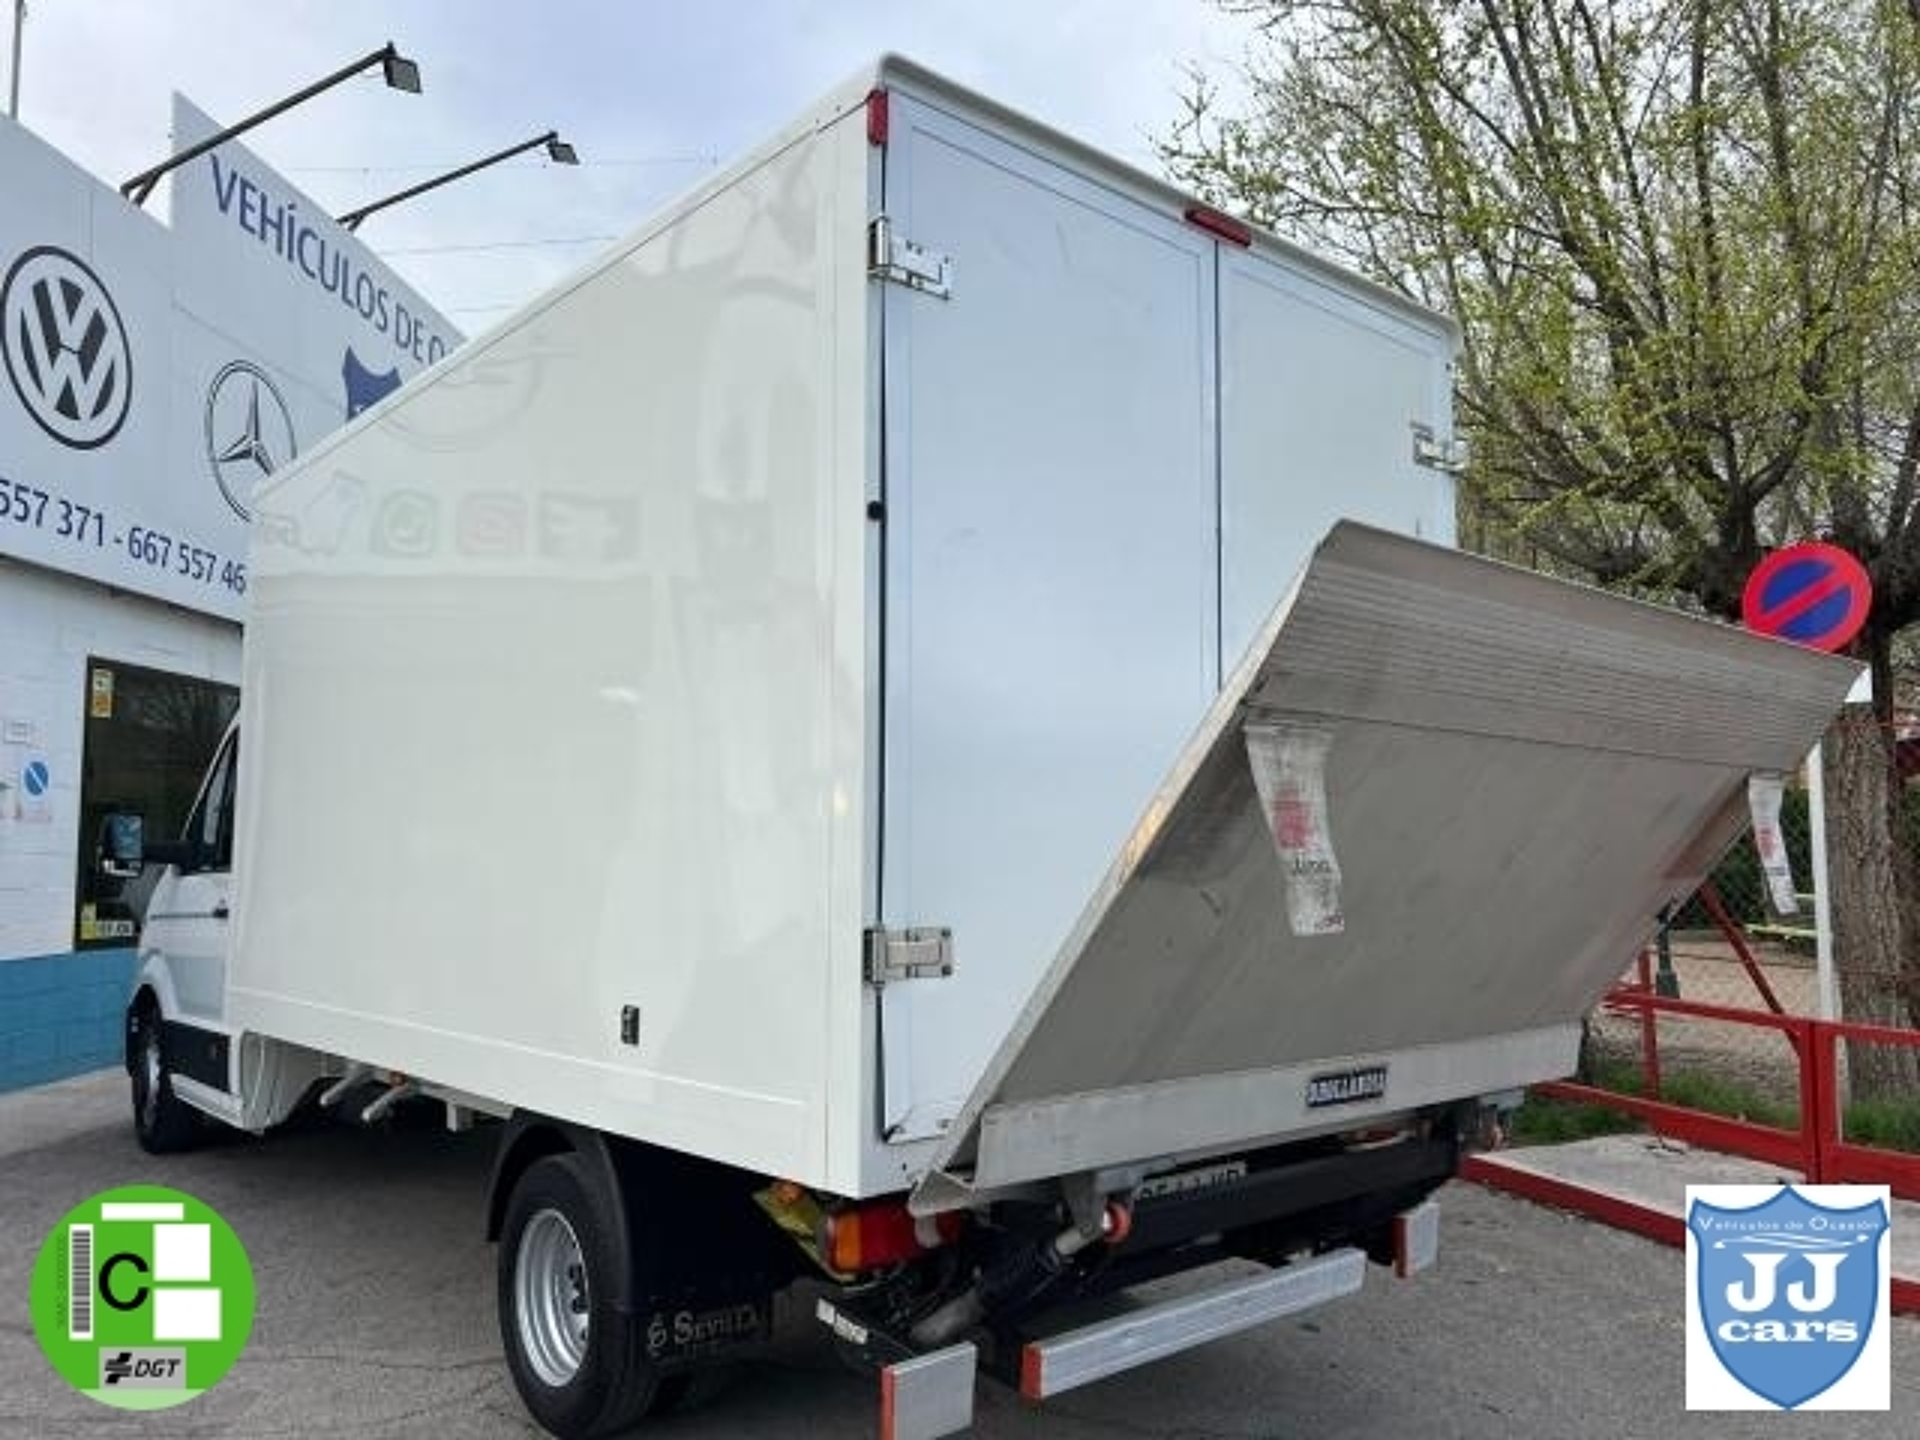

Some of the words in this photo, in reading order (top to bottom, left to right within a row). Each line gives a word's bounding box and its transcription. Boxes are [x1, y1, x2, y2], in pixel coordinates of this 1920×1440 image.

[210, 152, 388, 333] VEHÍCULOS
[395, 302, 426, 364] DE
[56, 499, 104, 548] 371
[128, 526, 172, 569] 667
[178, 542, 217, 584] 557
